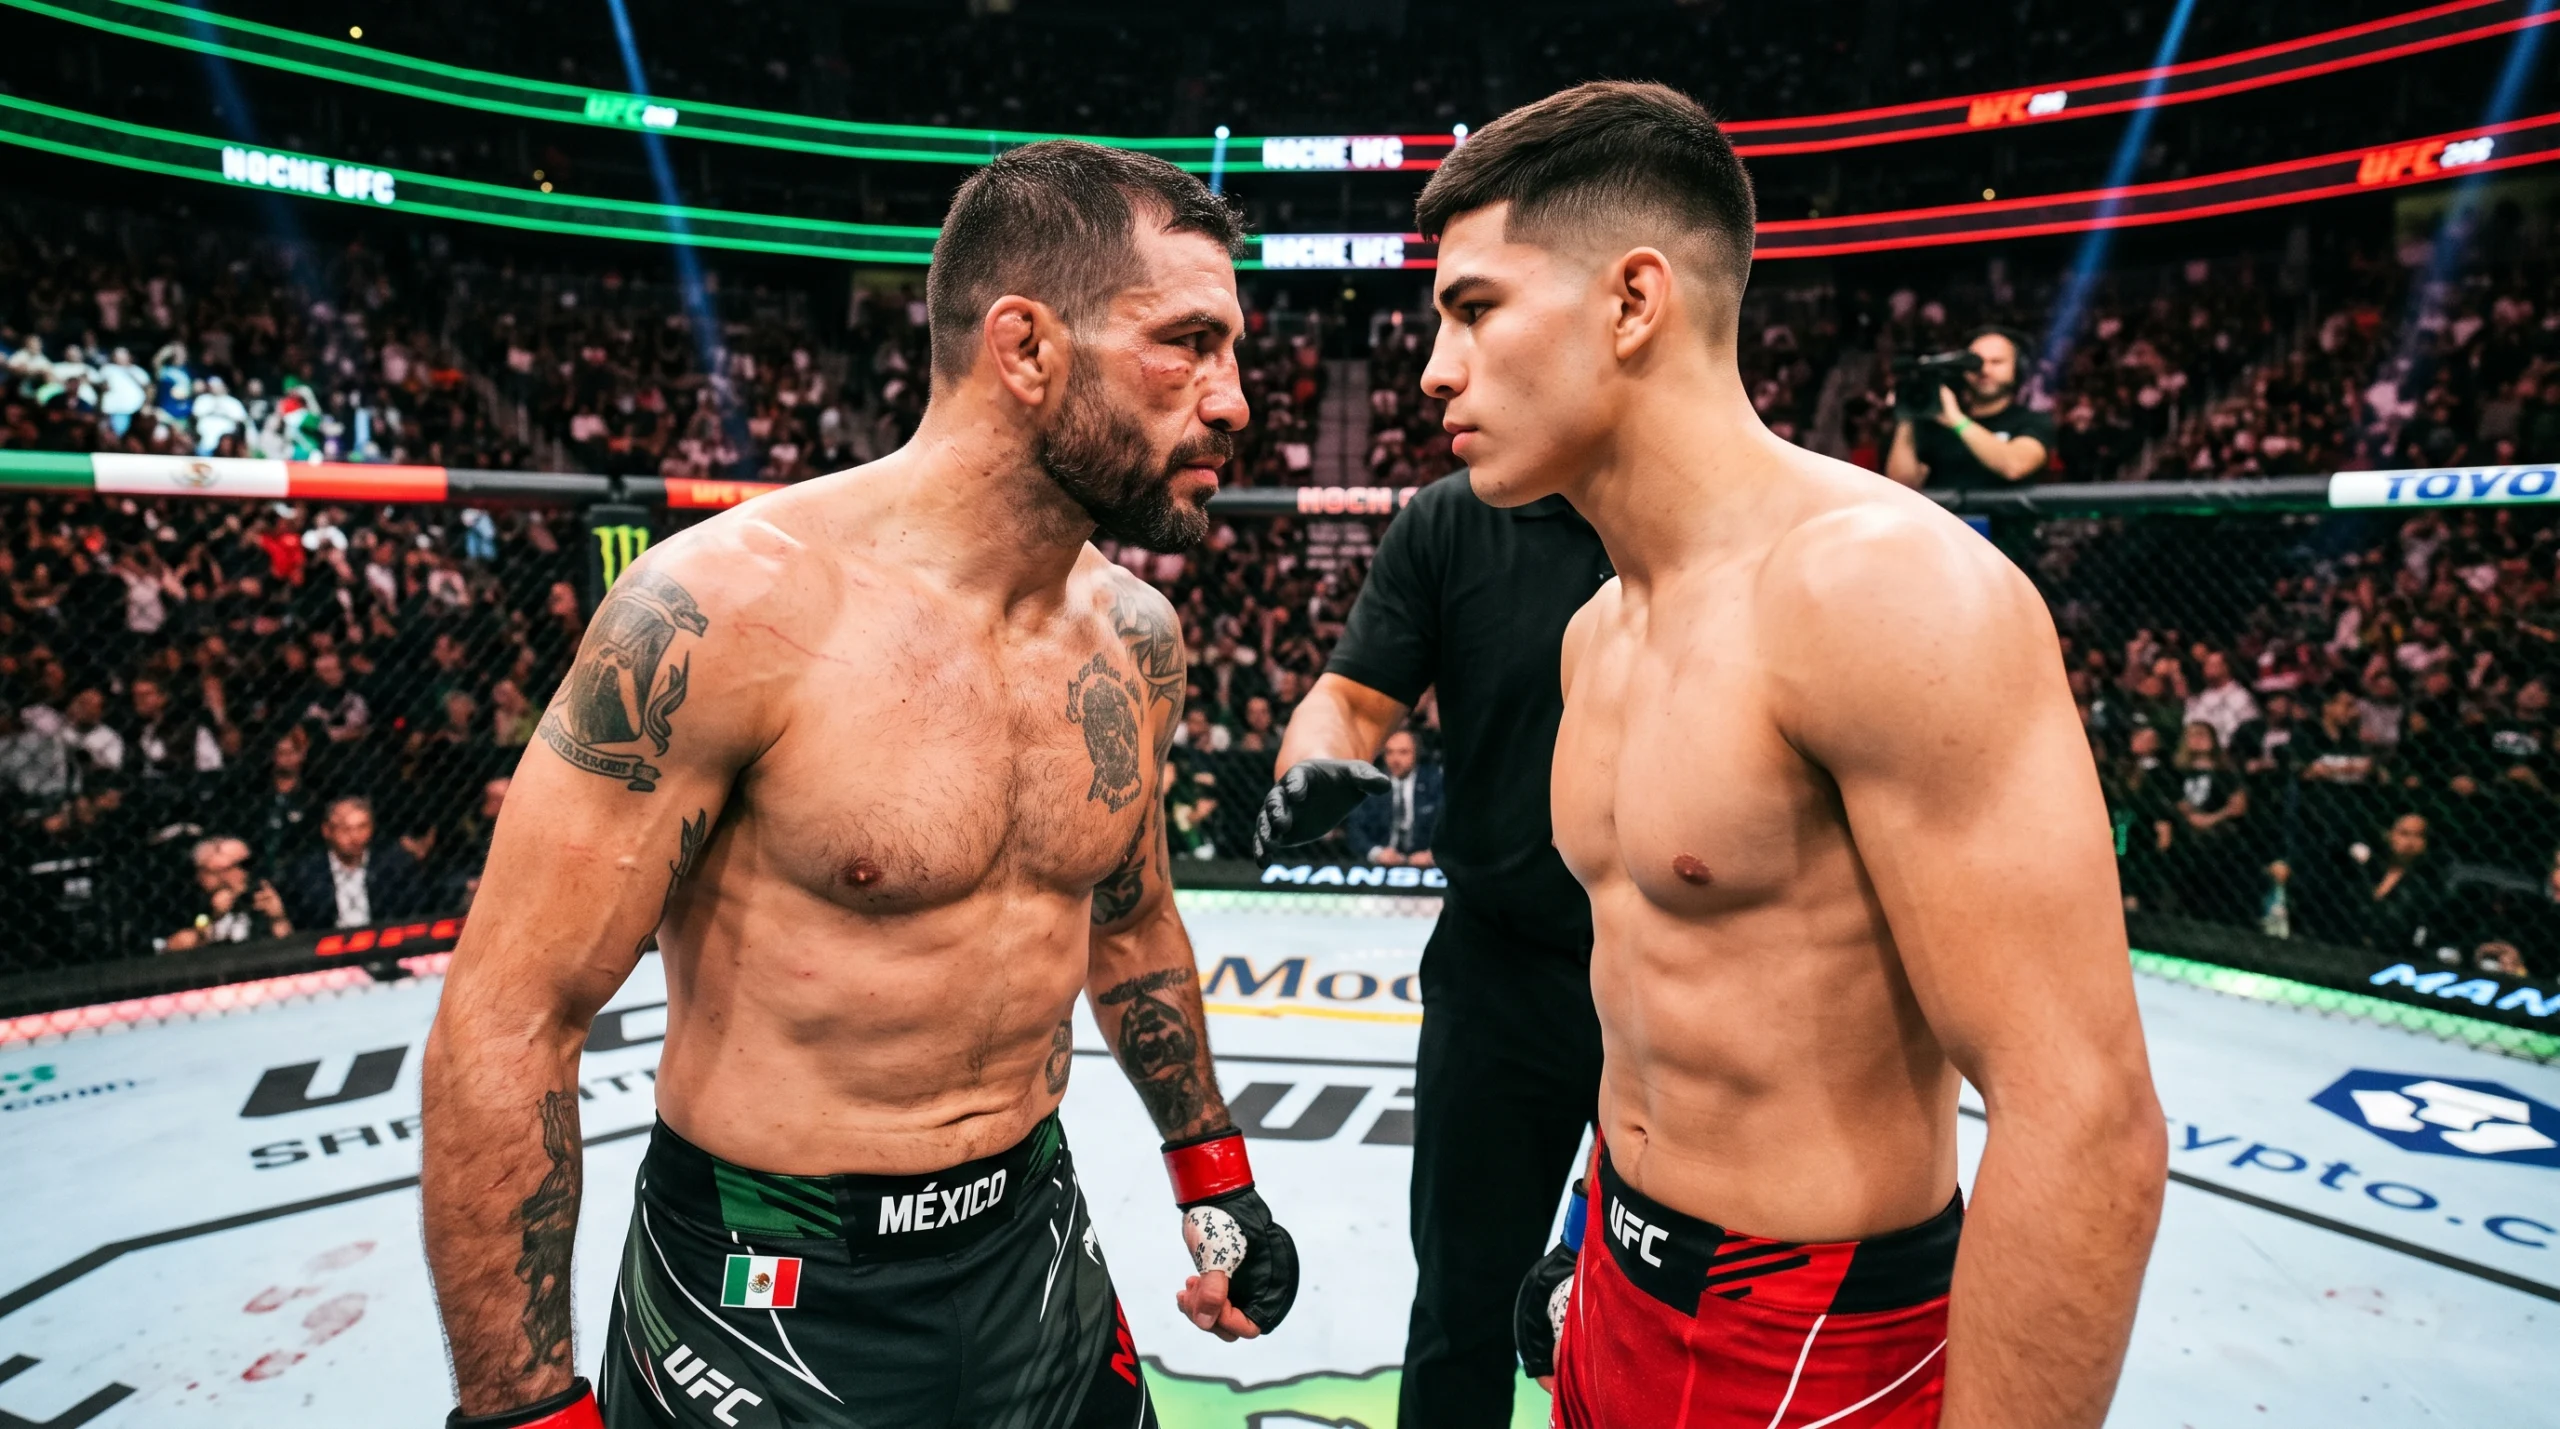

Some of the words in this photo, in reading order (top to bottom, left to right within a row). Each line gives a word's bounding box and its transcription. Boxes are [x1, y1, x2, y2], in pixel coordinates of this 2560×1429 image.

[222, 145, 331, 195] NOCHE
[334, 164, 396, 205] UFC
[1351, 137, 1404, 169] UFC
[2356, 140, 2446, 186] UFC
[1351, 235, 1405, 268] UFC
[2387, 470, 2557, 500] TOYO
[877, 1168, 1007, 1236] MÉXICO
[2165, 1117, 2559, 1249] ypto.c
[1609, 1195, 1670, 1268] UFC
[662, 1343, 763, 1428] UFC
